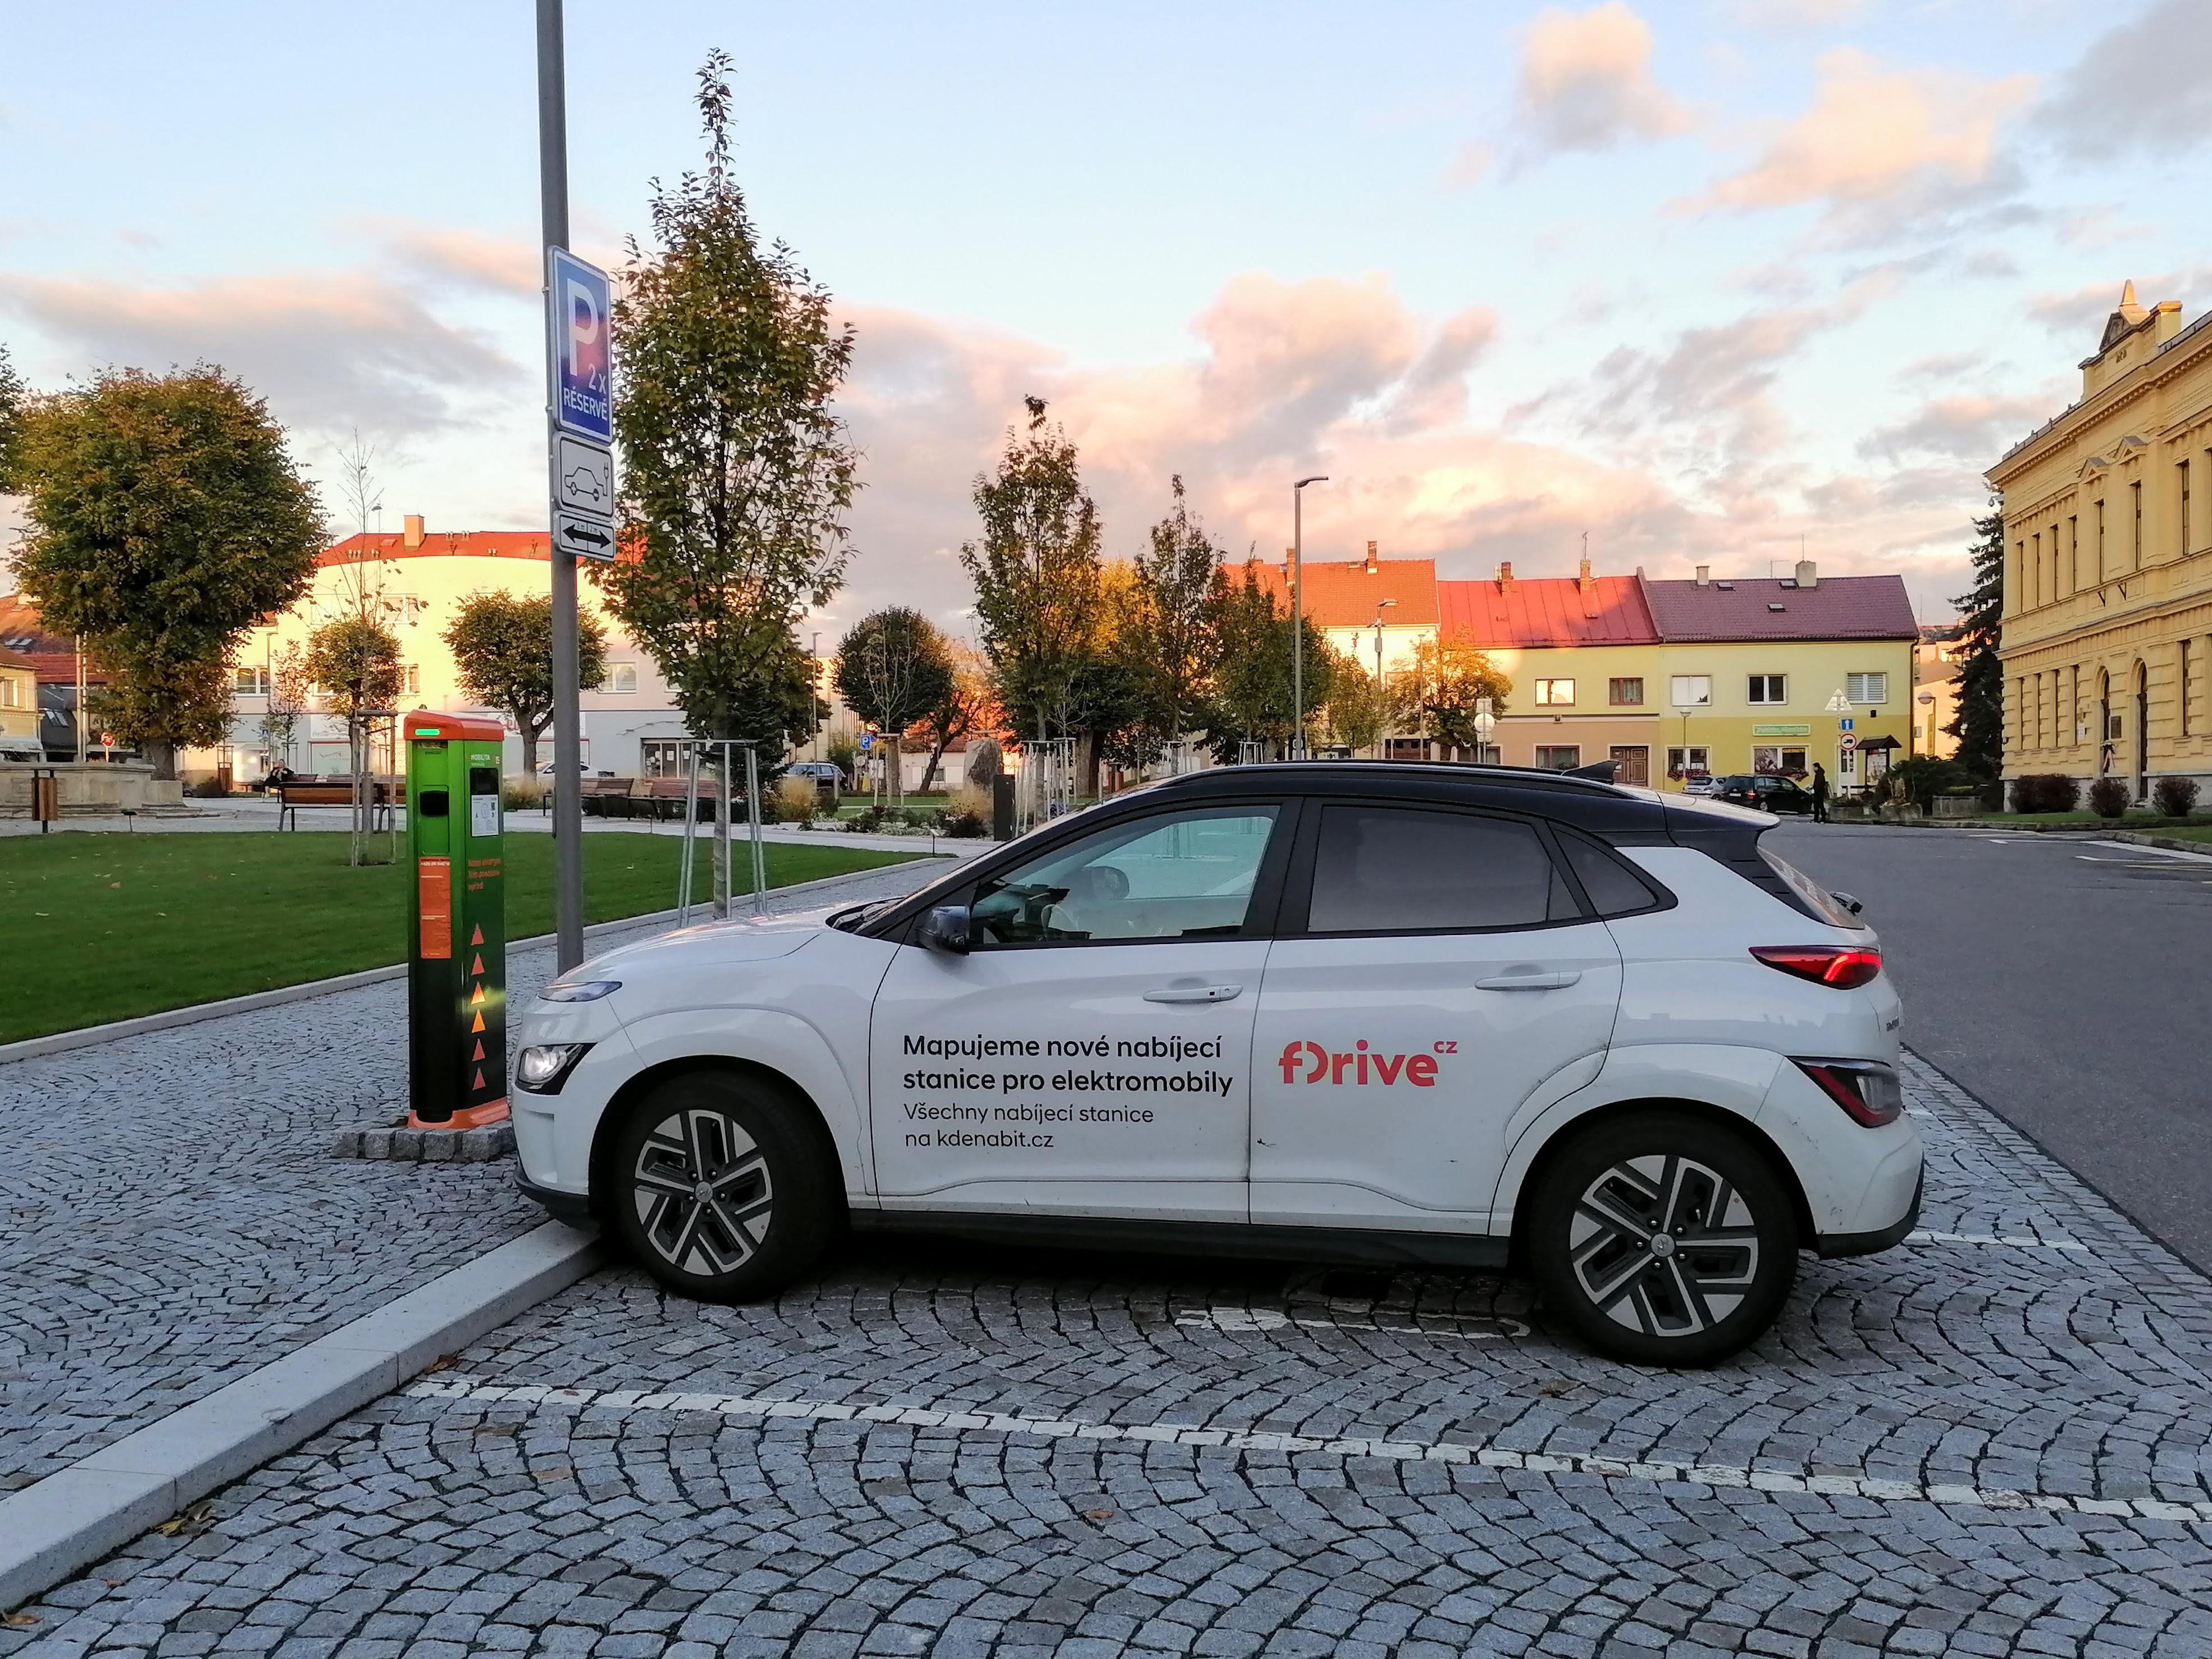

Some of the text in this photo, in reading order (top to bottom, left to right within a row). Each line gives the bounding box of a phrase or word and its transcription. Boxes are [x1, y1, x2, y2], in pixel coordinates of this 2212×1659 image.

[567, 277, 599, 377] P
[588, 363, 597, 391] 2
[563, 385, 608, 422] RÉSERVÉ
[904, 1034, 1223, 1063] Mapujeme nové nabíjecí
[903, 1067, 1233, 1098] stanice pro elektromobily
[903, 1102, 1154, 1125] Všechny nabíjecí stanice
[905, 1129, 1055, 1148] na kdenabit.cz
